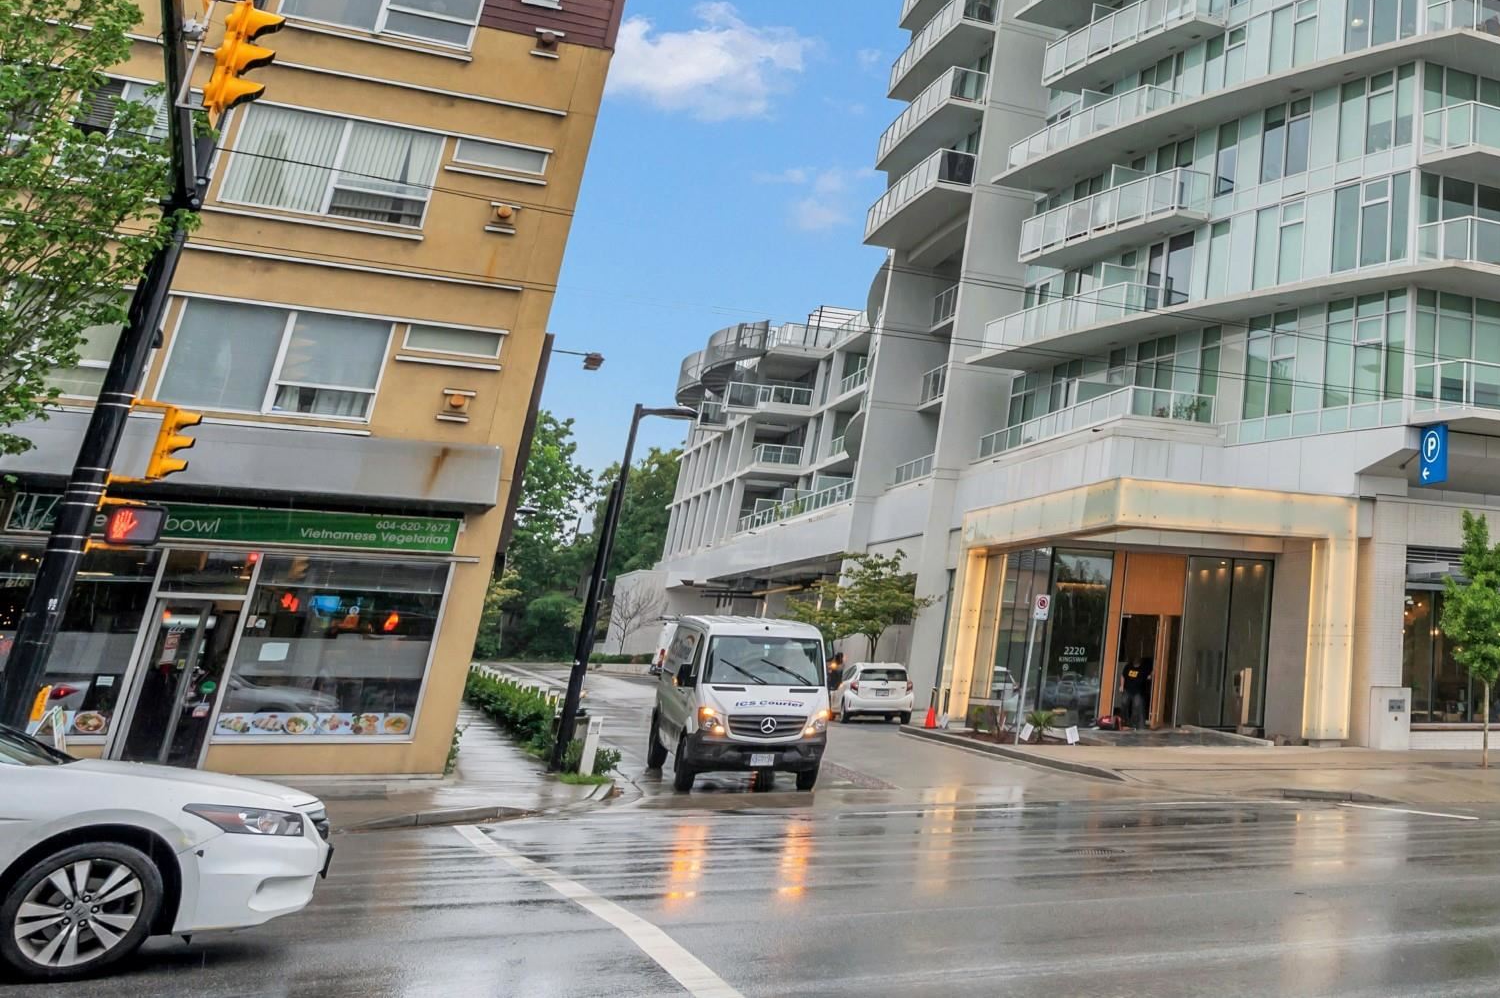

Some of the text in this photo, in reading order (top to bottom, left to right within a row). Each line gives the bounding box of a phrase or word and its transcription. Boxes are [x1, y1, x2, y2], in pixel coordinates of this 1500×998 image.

[163, 514, 221, 534] bowl
[375, 520, 451, 533] 604-620-7672
[300, 527, 449, 545] Vietnamese Vegetarian
[1063, 646, 1086, 656] 2220
[759, 700, 804, 708] Courier
